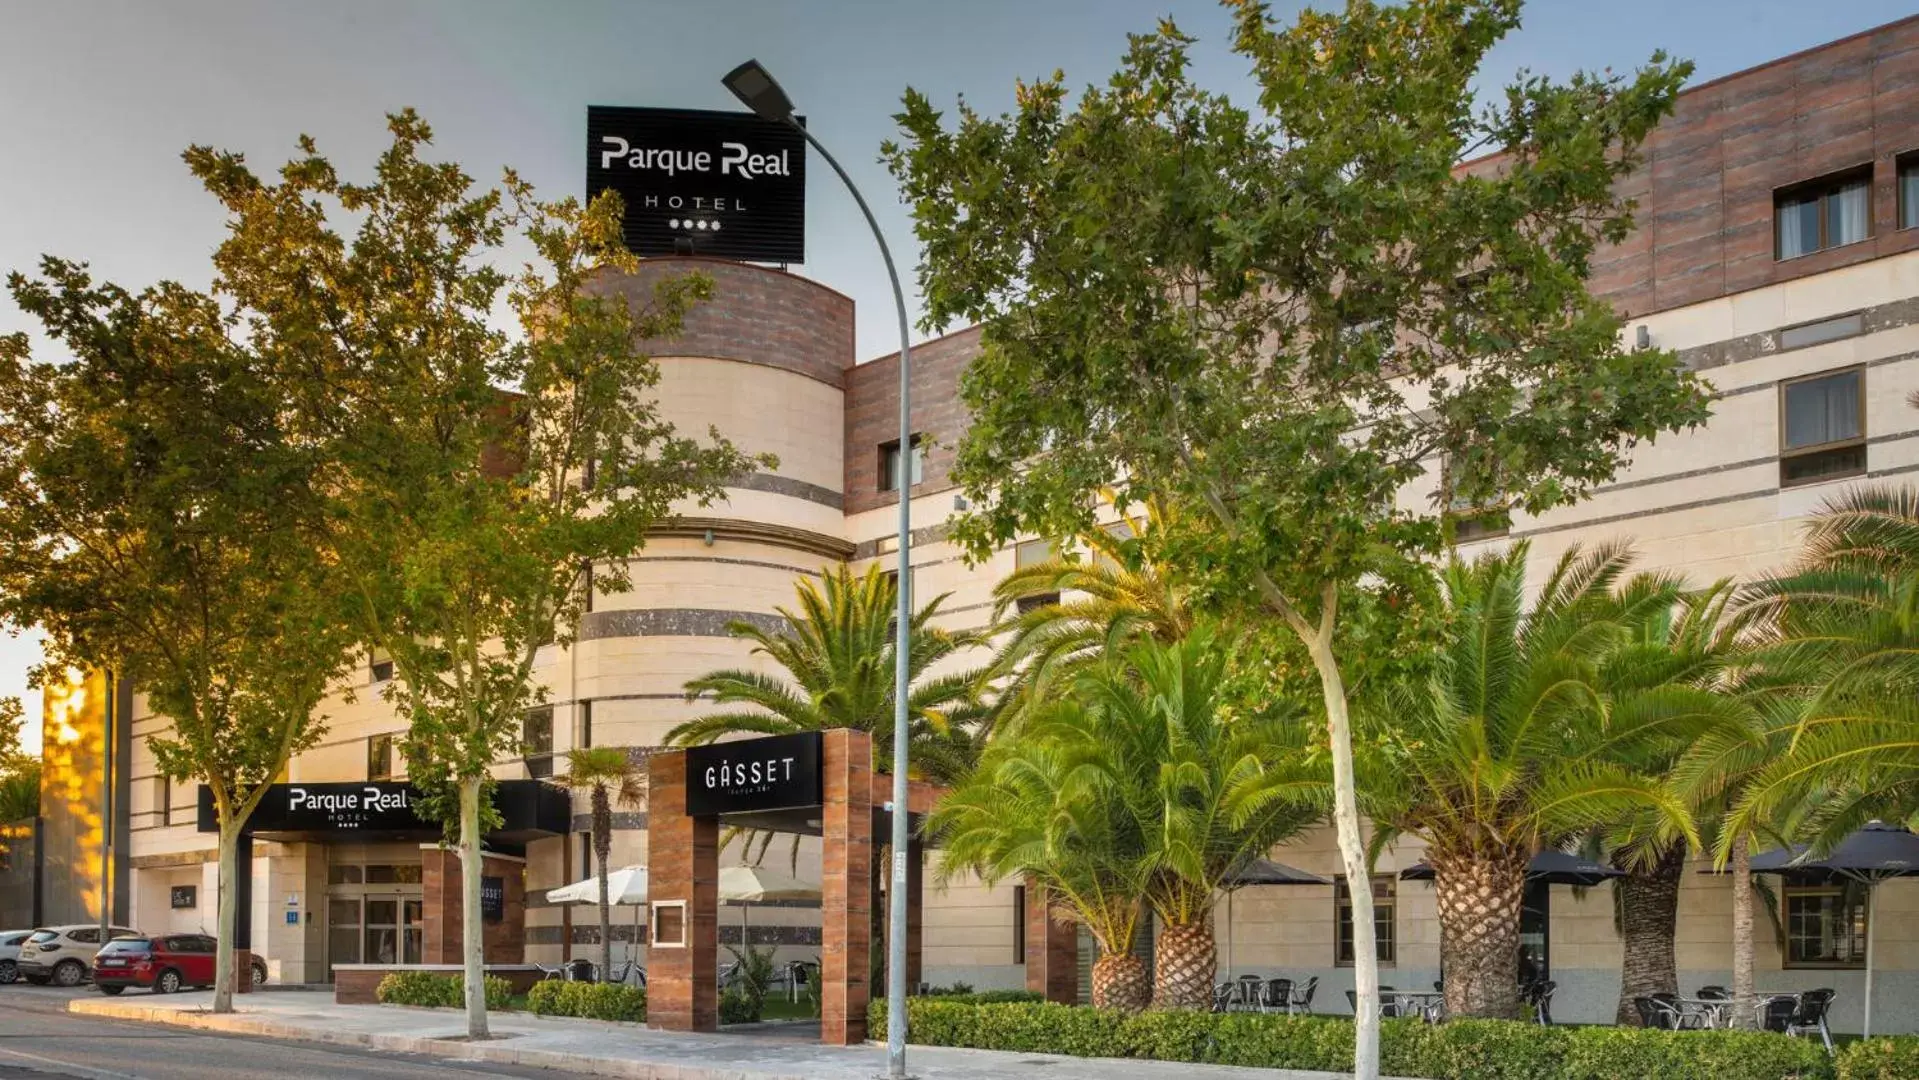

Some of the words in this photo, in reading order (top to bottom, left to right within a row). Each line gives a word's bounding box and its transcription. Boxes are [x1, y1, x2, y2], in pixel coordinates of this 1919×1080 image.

[602, 136, 711, 176] Parque
[722, 142, 790, 179] Real
[645, 195, 746, 211] HOTEL
[290, 788, 358, 813] Parque
[363, 787, 407, 812] Real
